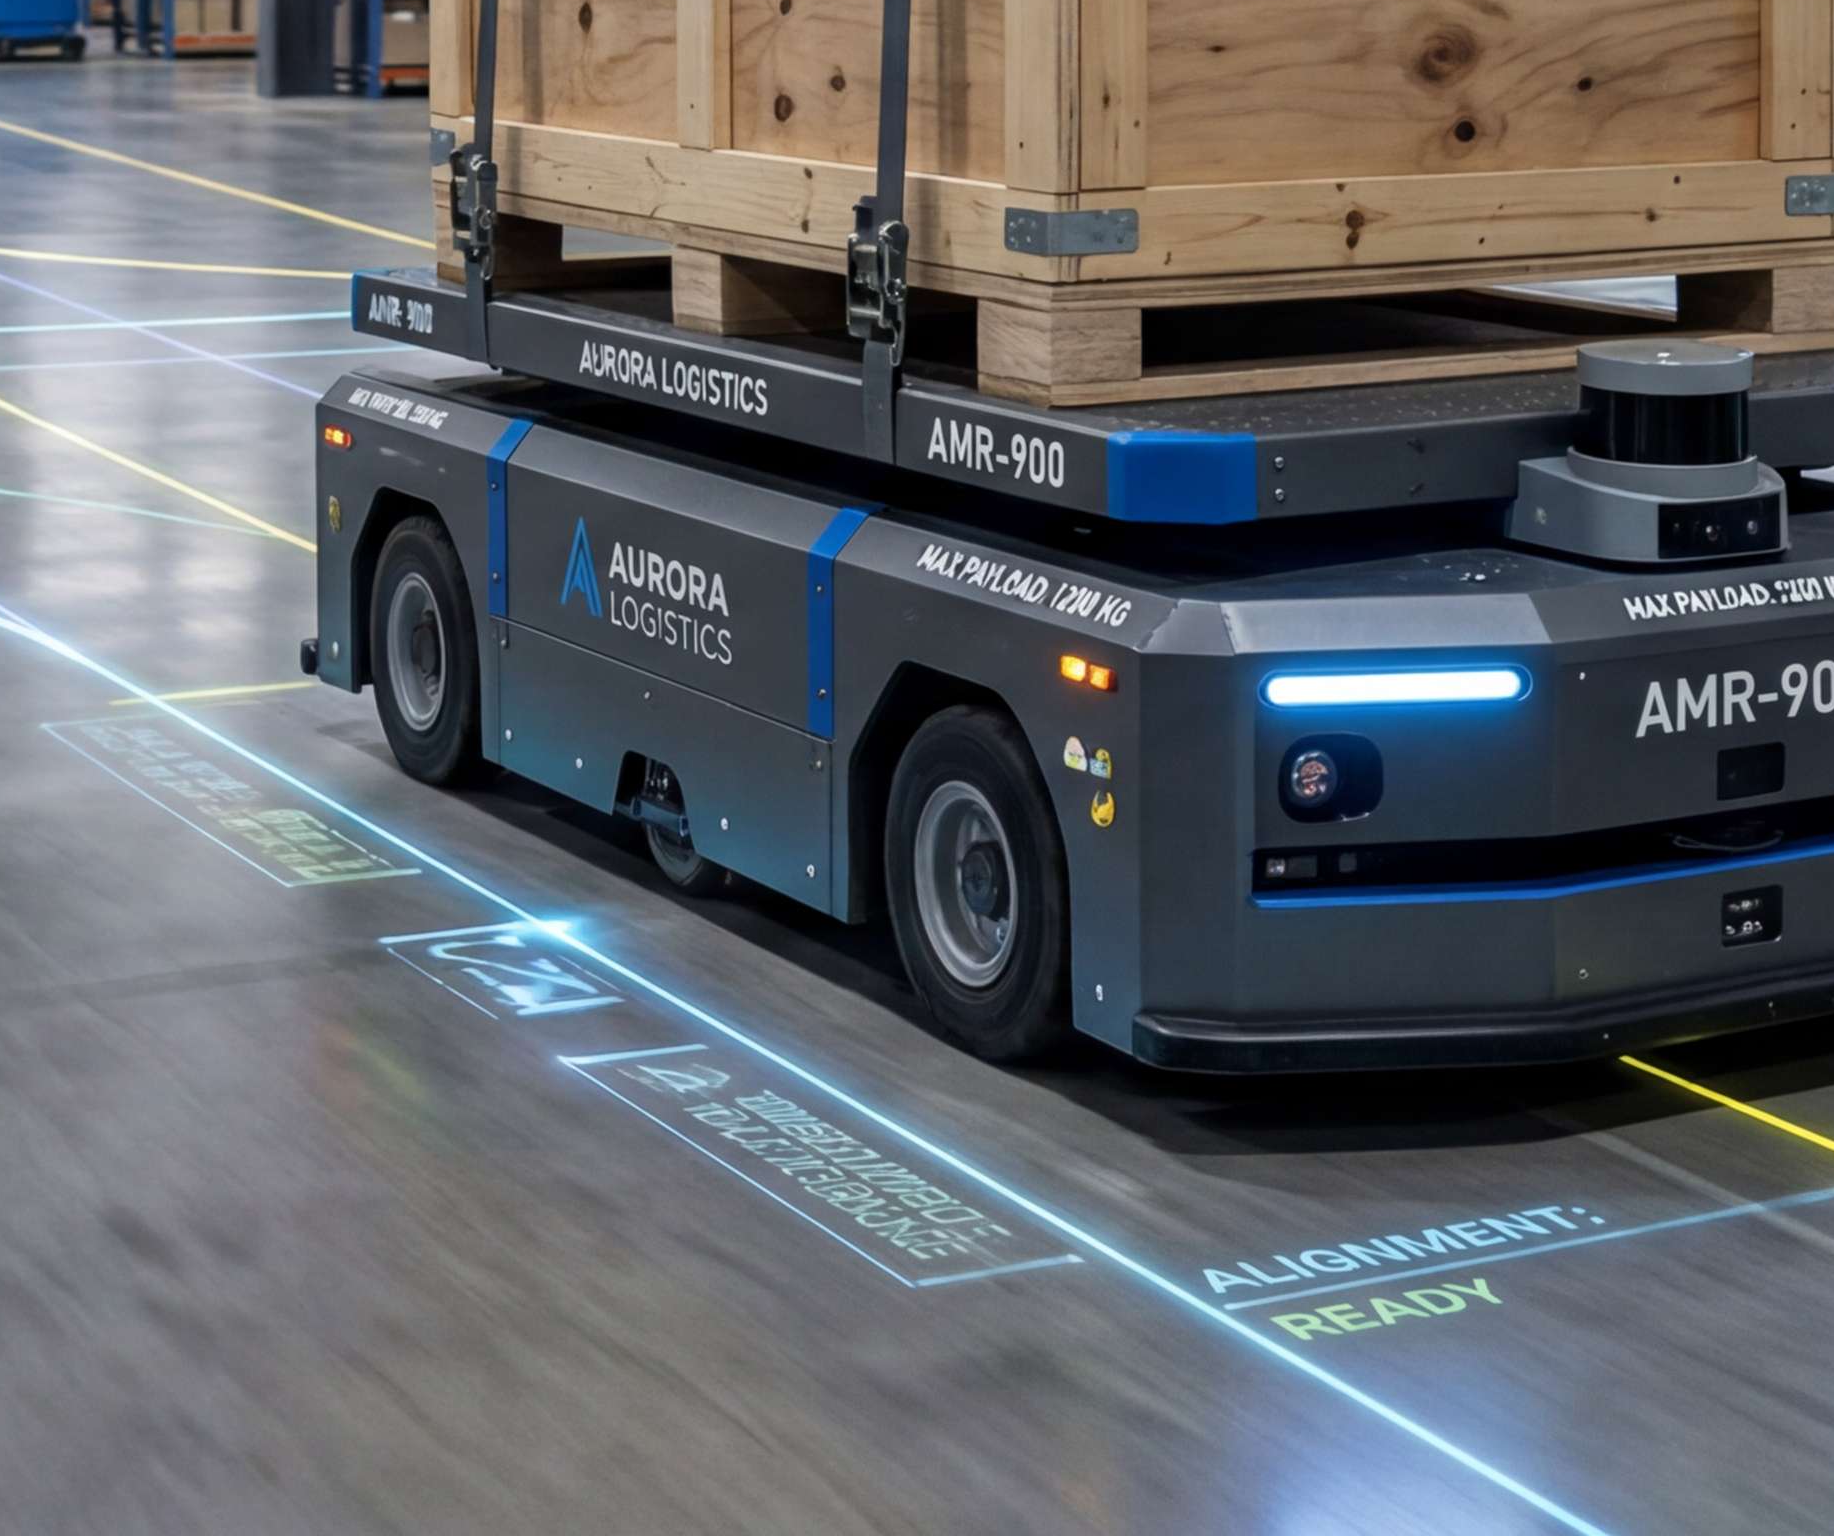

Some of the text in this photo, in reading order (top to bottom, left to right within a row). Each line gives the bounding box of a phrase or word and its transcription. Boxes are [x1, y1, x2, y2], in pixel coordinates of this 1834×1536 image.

[579, 340, 769, 415] AURORA LOGISTICS
[927, 417, 1065, 488] AMR-900
[608, 541, 729, 617] AURORA
[610, 590, 733, 664] LOGISTICS
[1202, 1205, 1606, 1294] ALIGNMENT:
[1270, 1278, 1504, 1341] READY
